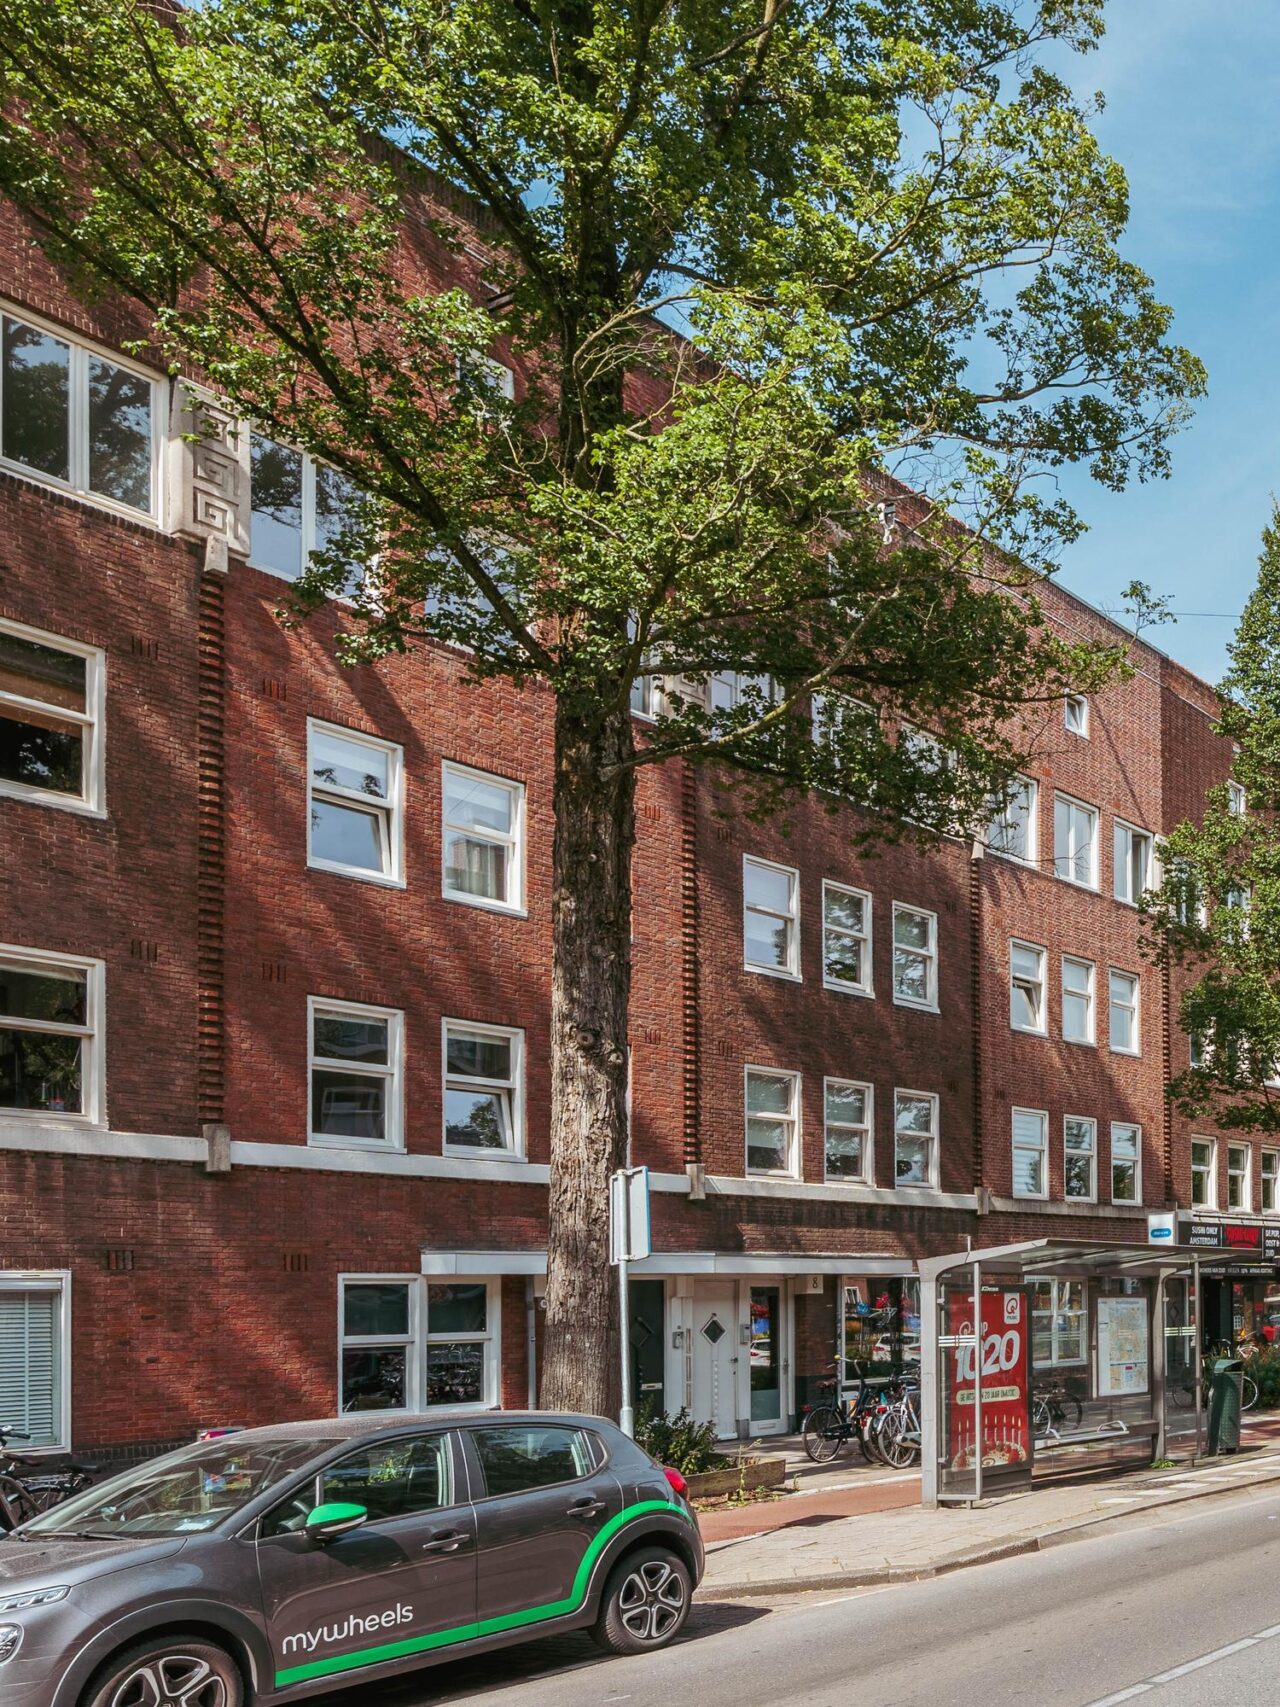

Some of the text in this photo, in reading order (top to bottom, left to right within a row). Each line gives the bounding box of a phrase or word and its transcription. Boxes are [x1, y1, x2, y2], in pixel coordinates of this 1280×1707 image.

[1191, 1226, 1219, 1235] SUSHI ONLY
[1189, 1237, 1219, 1246] AMSTERDAM
[811, 1276, 819, 1289] 8
[954, 1329, 1020, 1383] 1020
[281, 1602, 414, 1655] mywheels
